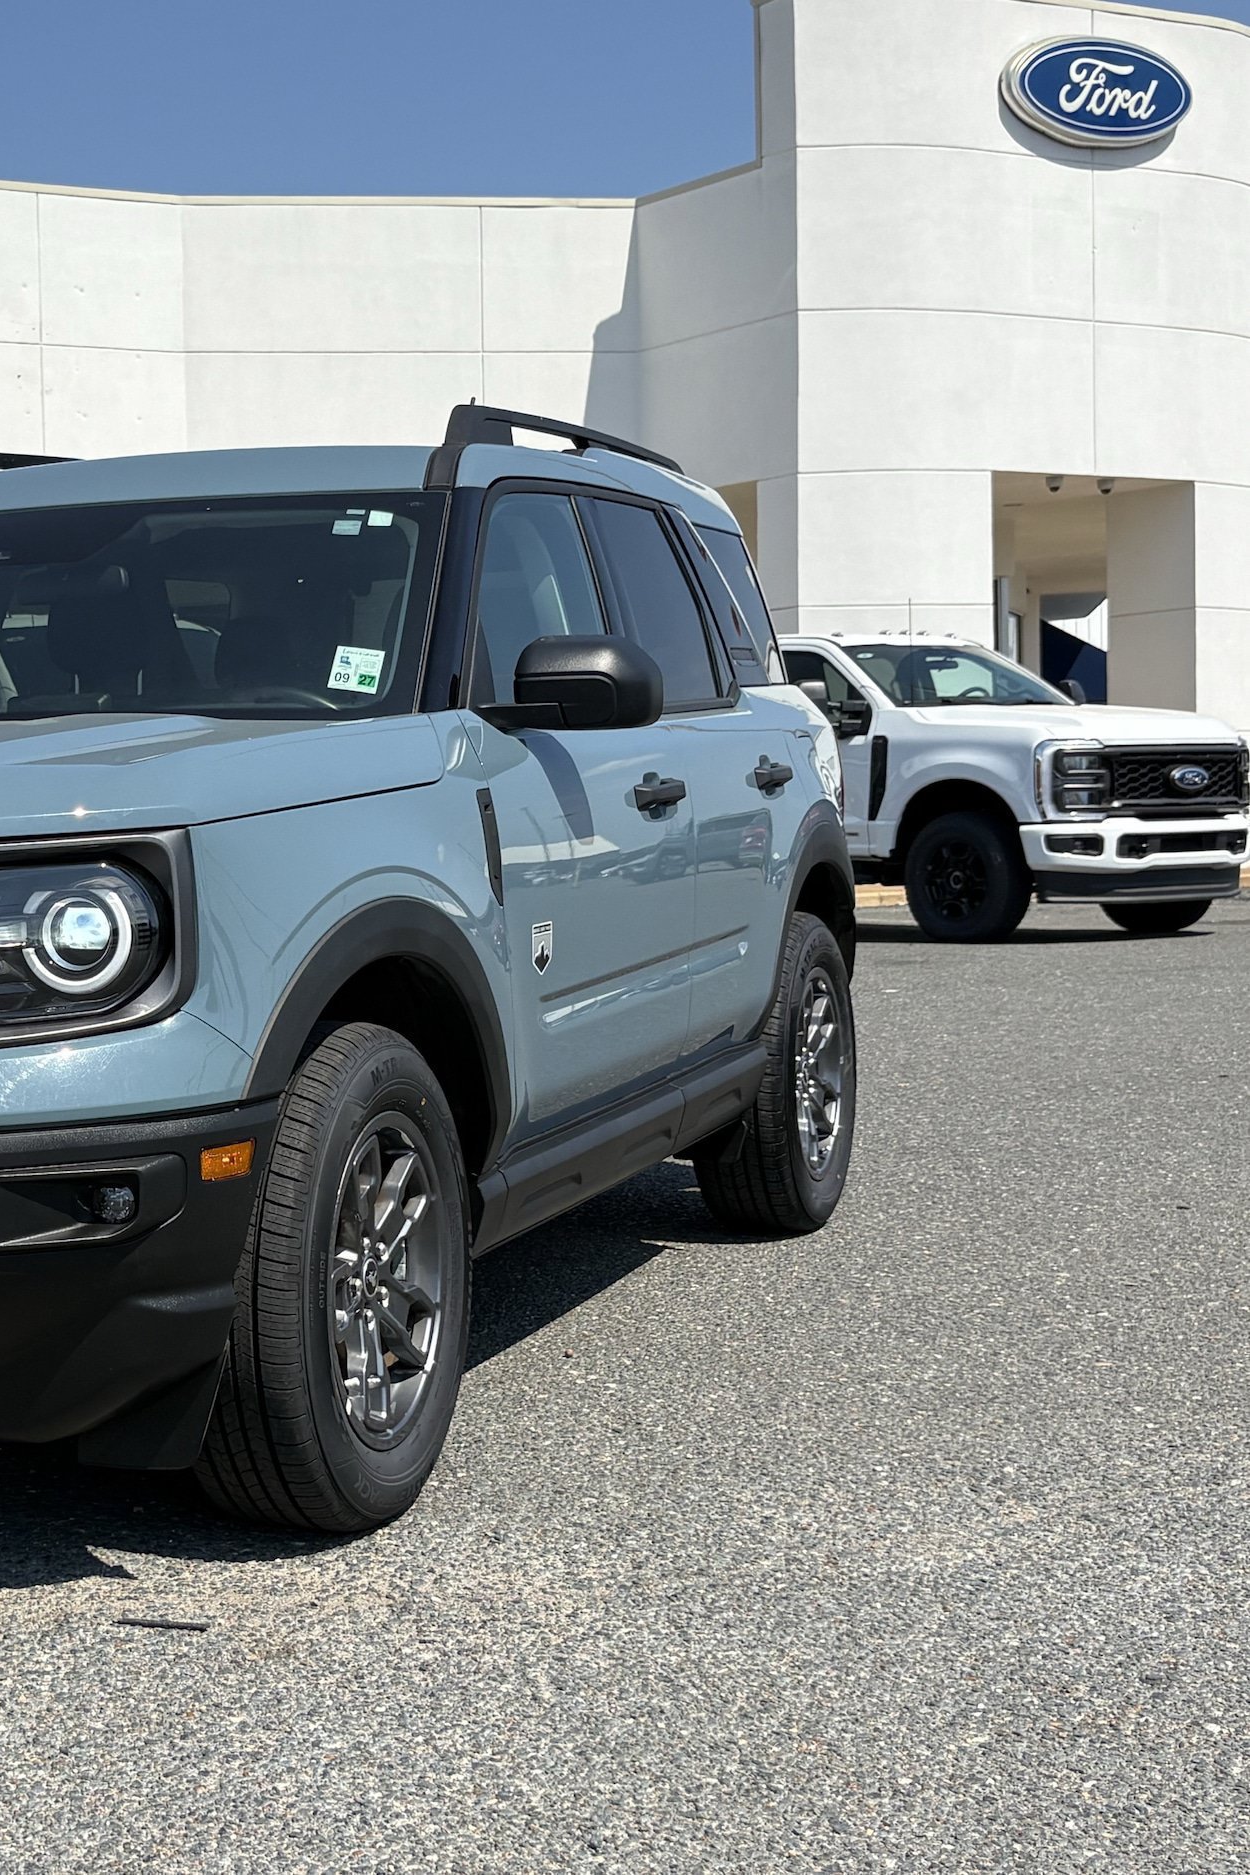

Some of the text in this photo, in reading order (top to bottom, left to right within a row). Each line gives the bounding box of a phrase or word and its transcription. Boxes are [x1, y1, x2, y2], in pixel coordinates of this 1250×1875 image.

[1059, 57, 1159, 120] Ford
[334, 671, 351, 683] 09
[358, 674, 375, 686] 27
